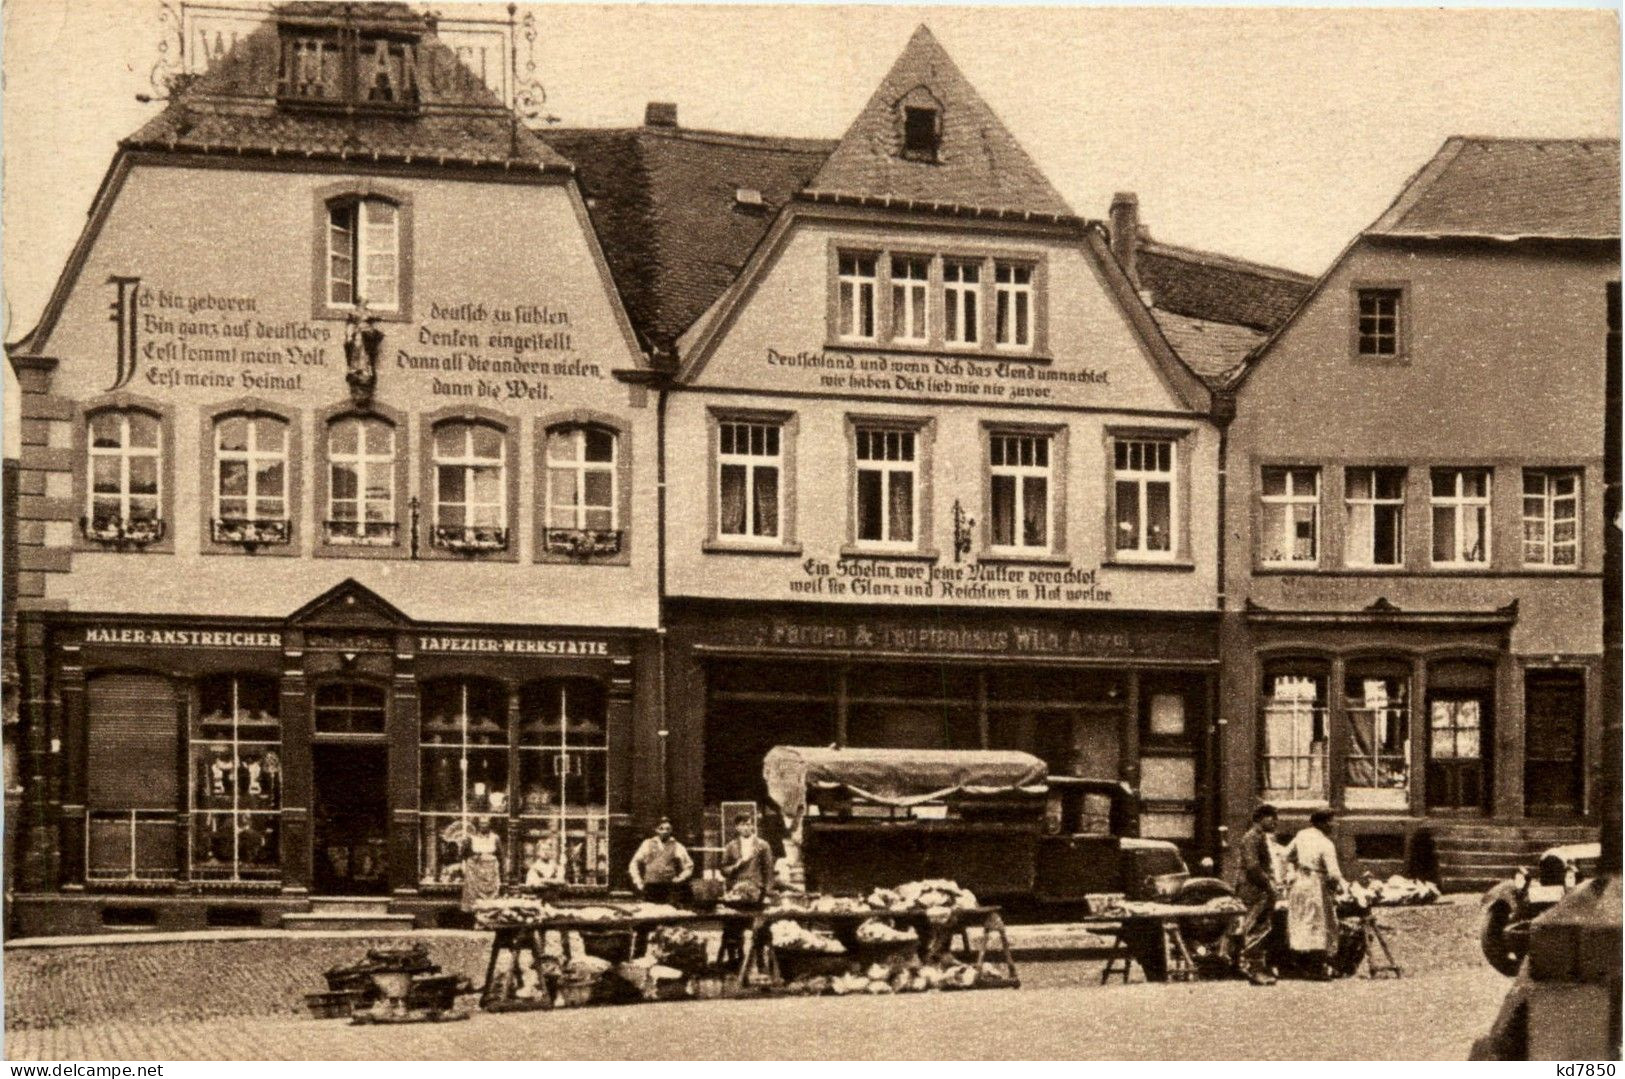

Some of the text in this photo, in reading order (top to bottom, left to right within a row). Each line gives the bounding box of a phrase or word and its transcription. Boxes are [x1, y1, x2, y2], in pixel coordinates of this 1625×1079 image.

[159, 289, 183, 309] bin
[144, 313, 175, 334] Bin
[179, 320, 218, 340] ganz
[223, 319, 251, 339] auf
[493, 307, 511, 326] zu
[418, 326, 479, 348] Denken
[181, 342, 237, 364] kommt
[240, 347, 282, 364] mein
[397, 350, 441, 370] Dann
[467, 354, 491, 373] die
[492, 356, 550, 374] andern
[185, 371, 235, 388] meine
[860, 357, 888, 371] und
[891, 362, 930, 375] wenn
[934, 358, 964, 376] Dich
[967, 362, 992, 378] das
[995, 363, 1035, 380] Elend
[432, 378, 473, 397] dann
[478, 379, 500, 399] die
[849, 375, 891, 391] haben
[895, 374, 925, 393] Dich
[927, 379, 952, 394] lieb
[955, 380, 980, 395] wie
[983, 383, 1005, 396] nie
[803, 558, 830, 577] Ein
[895, 564, 924, 580] wer
[789, 577, 823, 594] weil
[827, 577, 846, 595] sie
[851, 577, 900, 597] Glanz
[904, 581, 933, 598] und
[941, 581, 1010, 600] Reichtum
[1016, 585, 1029, 599] in
[1034, 584, 1060, 601] Not
[854, 624, 873, 647] &
